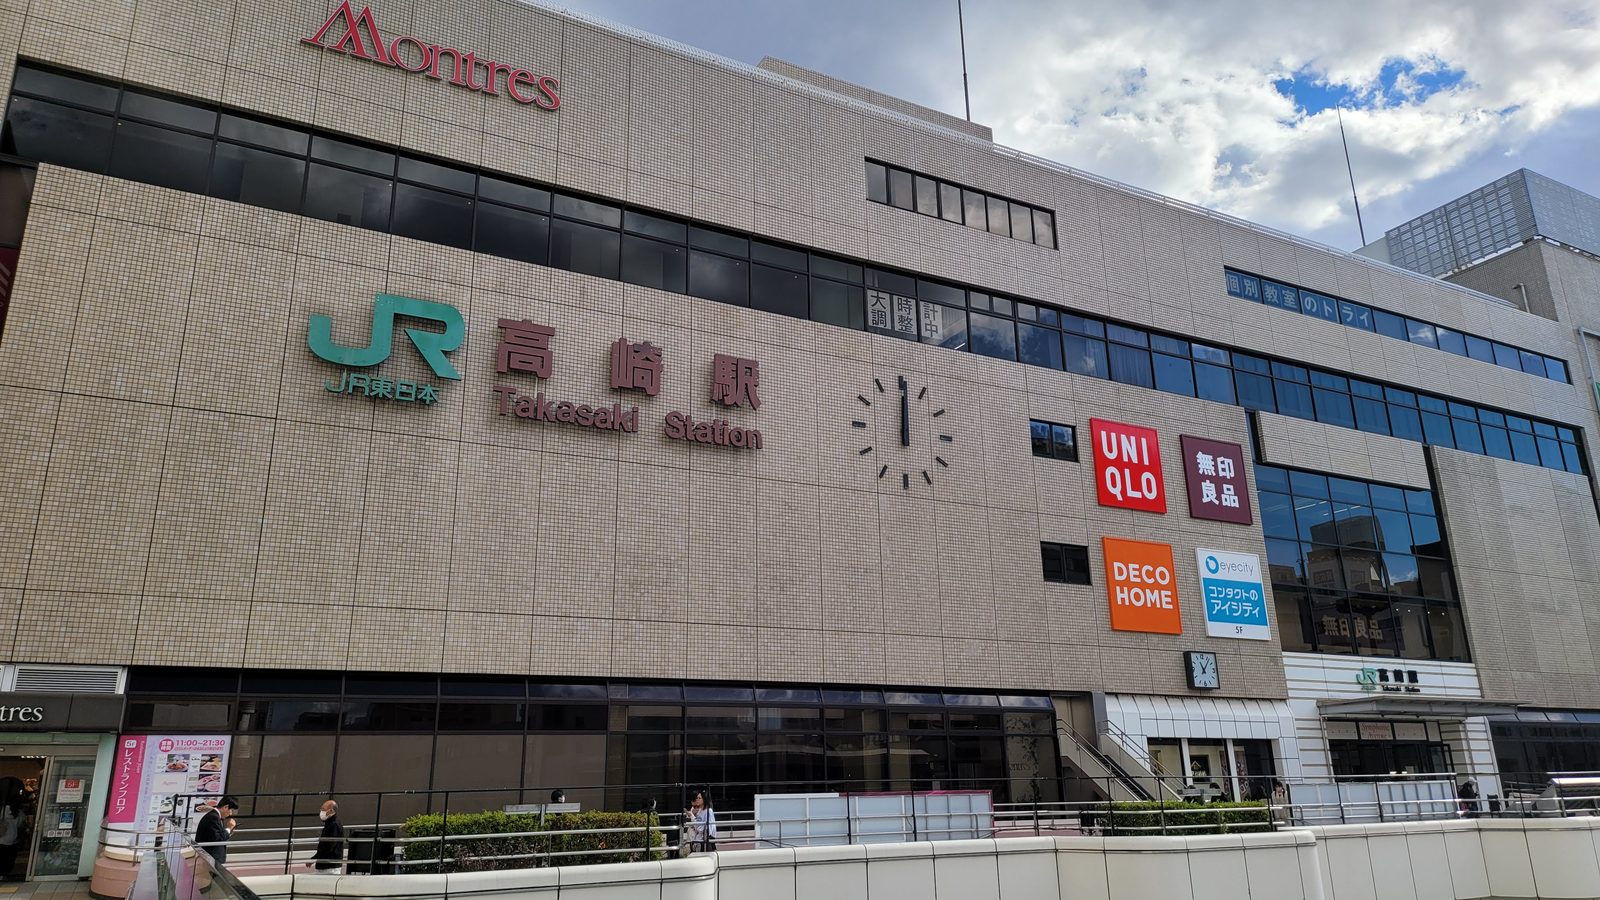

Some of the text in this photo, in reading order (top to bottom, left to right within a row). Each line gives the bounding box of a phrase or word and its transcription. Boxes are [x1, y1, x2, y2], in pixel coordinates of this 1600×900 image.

[301, 0, 561, 110] Montres
[1227, 274, 1369, 327] 個別教室のトライ
[308, 292, 465, 381] JR
[497, 318, 762, 410] 高崎駅
[324, 367, 441, 405] JR東日本
[493, 385, 763, 449] Takasaki Station
[1101, 430, 1149, 465] UNI
[1196, 451, 1235, 479] 無印
[1105, 466, 1157, 501] QLO
[1201, 479, 1240, 508] 良品
[1113, 561, 1170, 585] DECO
[1219, 561, 1254, 576] eyecity
[1116, 586, 1173, 609] HOME
[1209, 586, 1258, 601] コンタクトの
[1210, 600, 1260, 618] アイシティ
[1235, 626, 1243, 634] 5F
[1356, 668, 1377, 685] JR
[115, 749, 134, 815] レストランフロア
